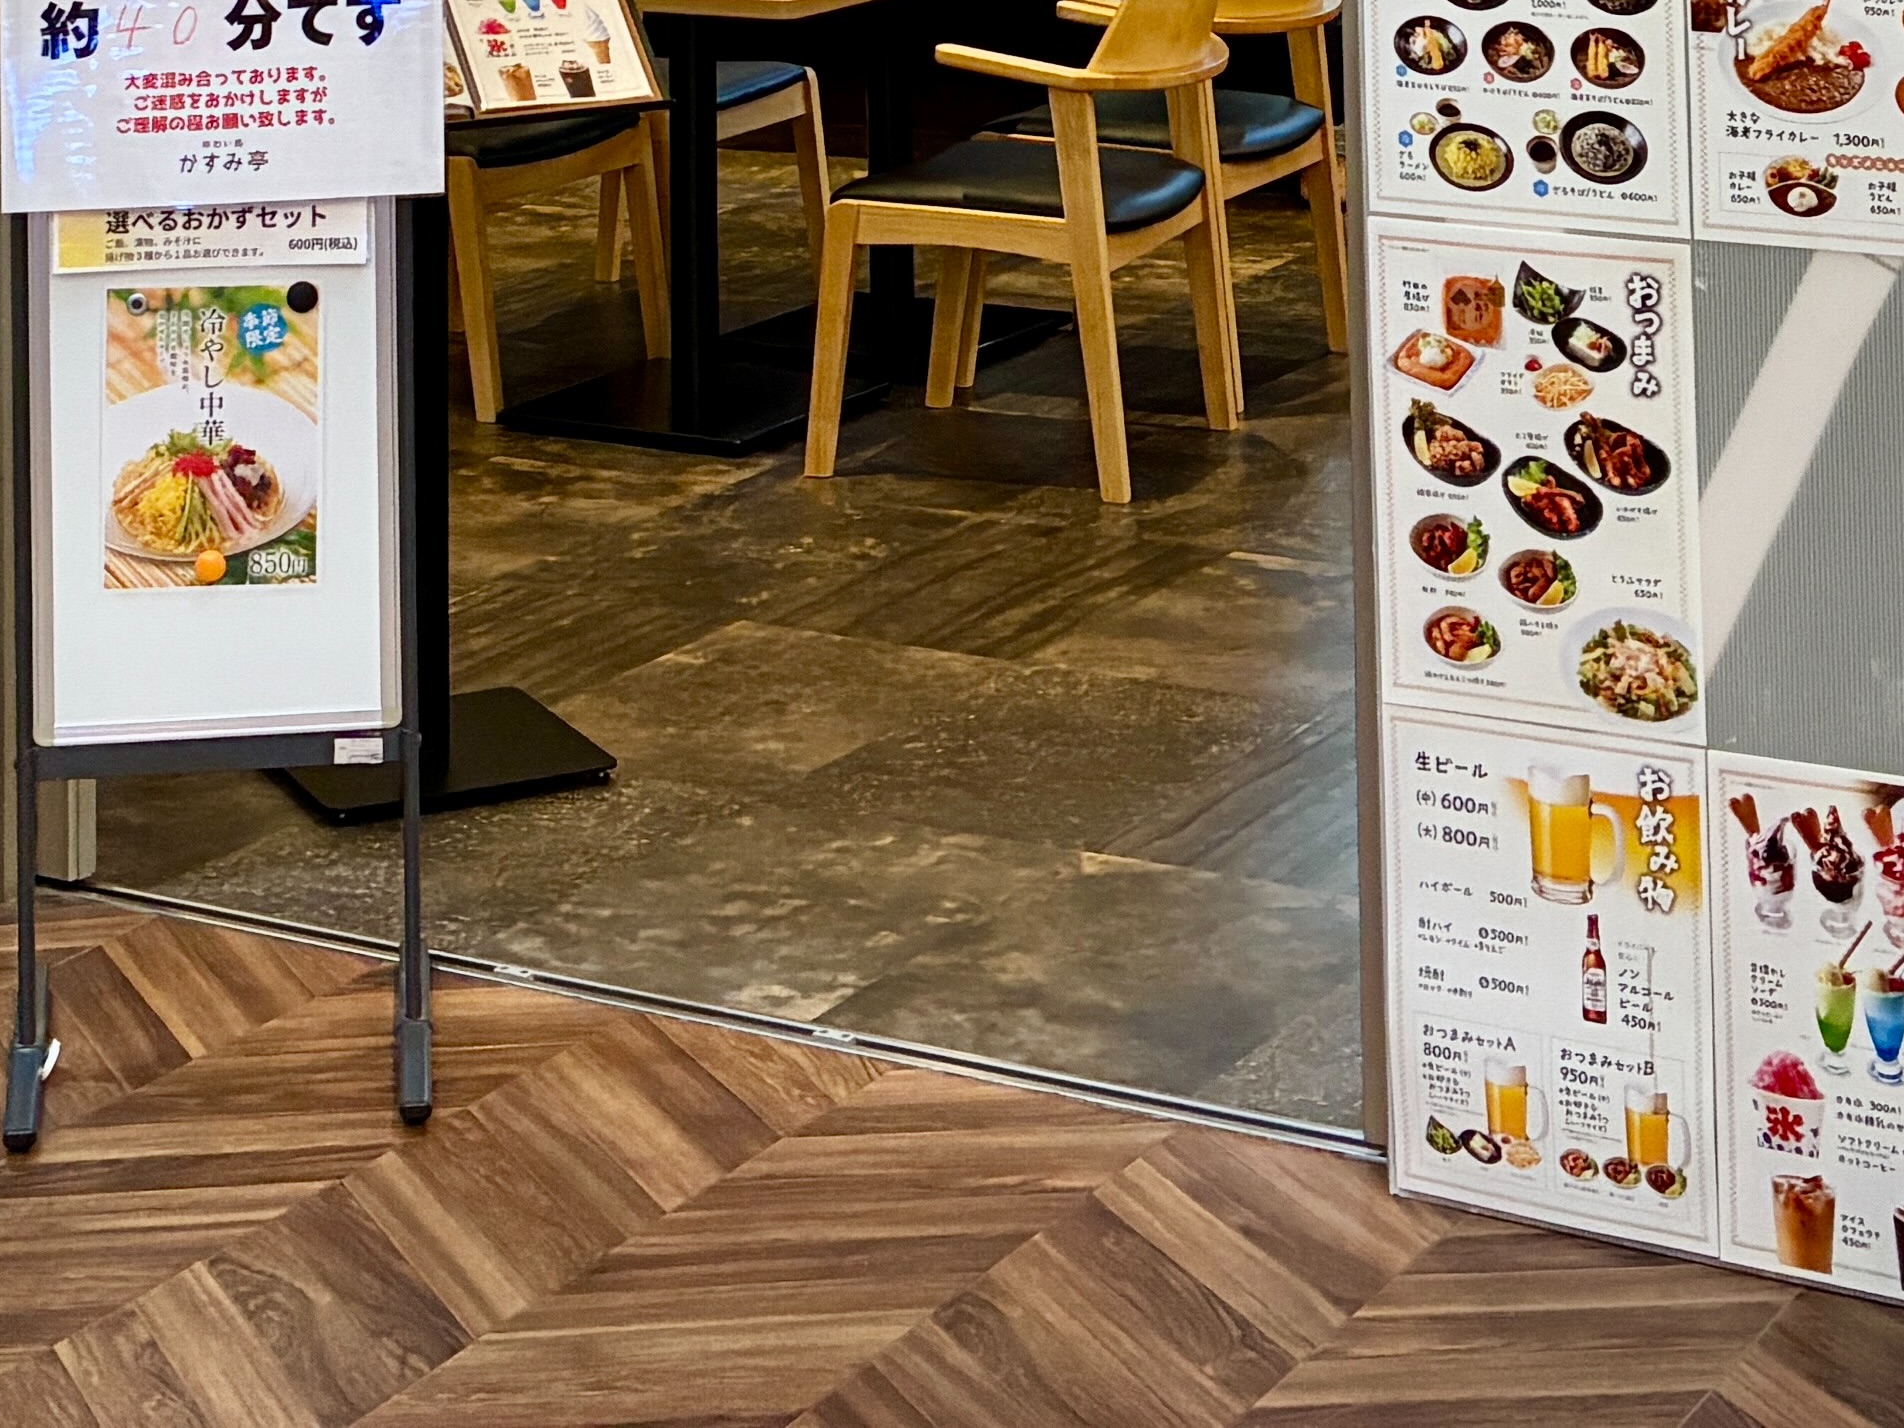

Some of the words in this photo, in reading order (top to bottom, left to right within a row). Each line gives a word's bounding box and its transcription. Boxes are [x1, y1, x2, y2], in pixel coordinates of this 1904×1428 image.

[40, 0, 100, 60] 約
[124, 65, 330, 90] 大変混み合っております。
[133, 87, 328, 112] ご迷惑をおかけしますが
[115, 108, 338, 135] ご理解の程お願い致します。
[1725, 124, 1820, 144] 海老フライカレー
[178, 149, 270, 174] かすみ亭
[105, 204, 327, 235] 選べるおかずセット
[287, 237, 359, 252] 600円(税込)
[242, 308, 279, 331] 季節
[245, 325, 284, 349] 限定
[1627, 273, 1663, 399] おつまみ
[198, 307, 226, 447] 冷やし中華
[247, 549, 309, 578] 850円
[1415, 750, 1489, 779] 生ビール
[1441, 792, 1489, 816] 600円
[1442, 825, 1491, 850] 800円
[1635, 765, 1680, 913] お飲み物
[1419, 879, 1473, 897] ハイボール
[1617, 982, 1675, 1001] アルコール
[1619, 997, 1654, 1014] ビール
[1765, 1105, 1805, 1143] 氷
